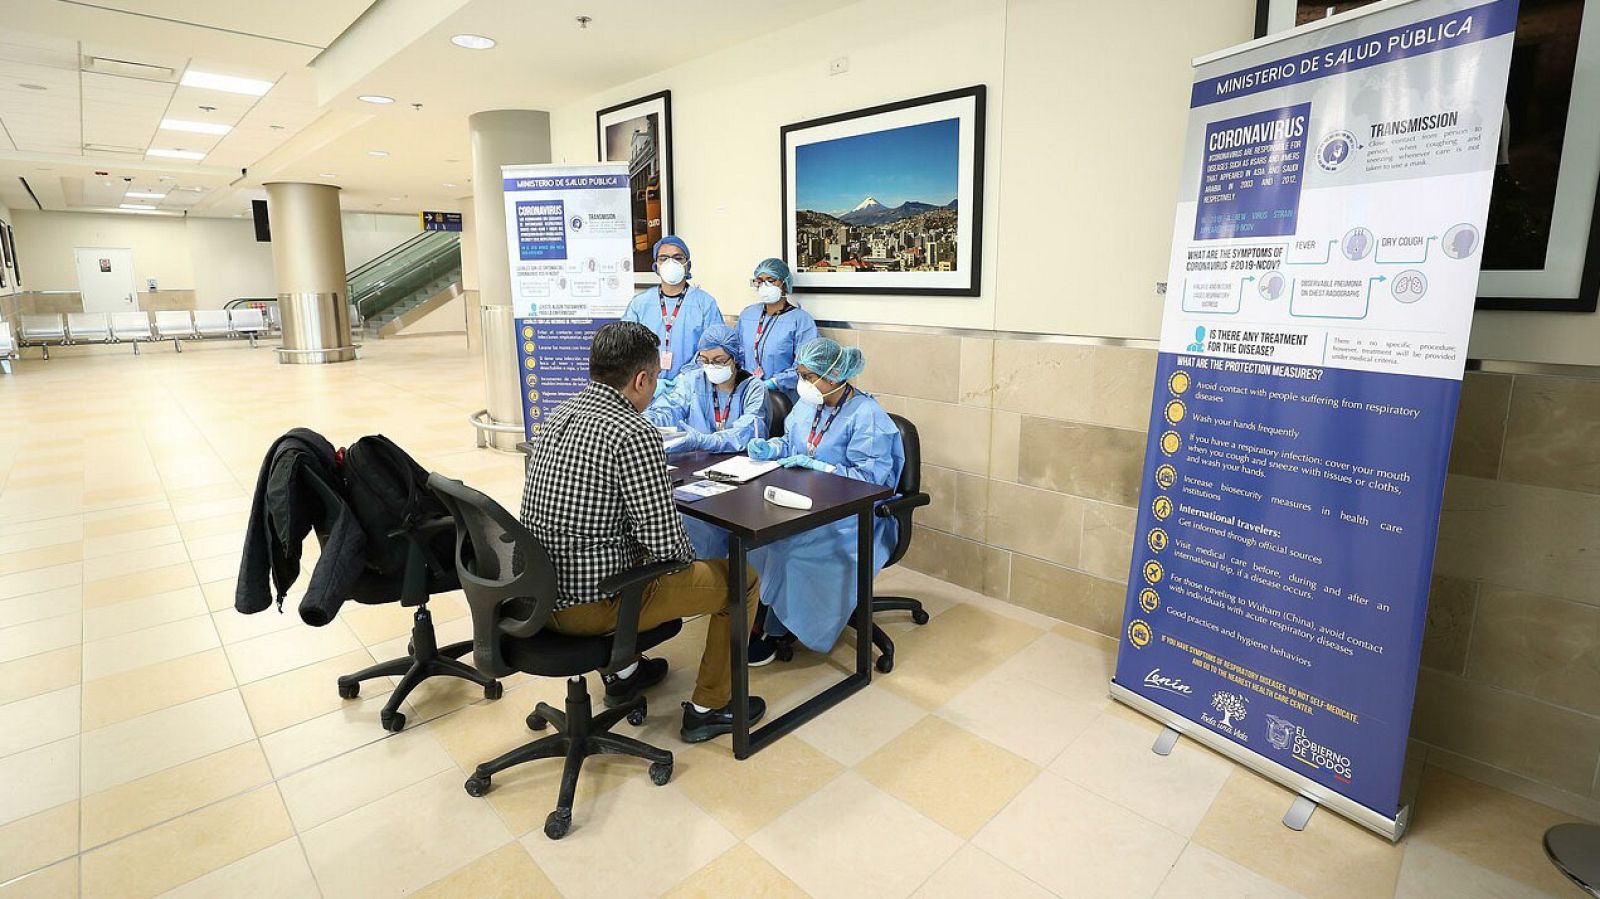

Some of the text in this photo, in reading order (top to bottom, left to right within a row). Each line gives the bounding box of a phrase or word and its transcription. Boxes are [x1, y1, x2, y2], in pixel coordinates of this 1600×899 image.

[1217, 16, 1472, 95] MINISTERIO DE SALUD PÚBLICA
[1209, 117, 1304, 151] CORONAVIRUS
[1371, 111, 1458, 138] TRANSMISSION
[1291, 140, 1301, 149] FOR
[1230, 161, 1241, 169] SUCH
[1283, 164, 1298, 173] SAUDI
[516, 179, 555, 188] MINISTERIO
[555, 179, 564, 187] DE
[565, 178, 588, 186] SALUD
[1261, 178, 1275, 187] AND
[1188, 248, 1283, 259] WHAT ARE THE SYMPTOMS OF
[1296, 241, 1316, 249] FEVER
[1382, 236, 1423, 247] DRY COUGH
[1186, 261, 1228, 271] CORONAVIRUS
[1207, 342, 1275, 356] FOR THE DISEASE?
[1210, 329, 1308, 346] IS THERE ANY TREATMENT
[1177, 356, 1324, 381] WHAT ARE THE PROTECTION MEASURES?
[1195, 392, 1223, 402] diseases
[1196, 382, 1420, 419] Avoid contact with people suffering from respiratory
[1193, 413, 1212, 423] Wash
[1233, 420, 1256, 430] hands
[1258, 424, 1299, 439] frequently
[1188, 445, 1207, 454] when
[1226, 453, 1249, 463] cough
[1251, 458, 1267, 466] and
[1269, 462, 1298, 472] sneeze
[1301, 467, 1321, 476] with
[1324, 471, 1352, 483] tissues
[1368, 480, 1401, 495] cloths,
[1201, 459, 1220, 467] wash
[1222, 463, 1240, 471] your
[1241, 465, 1266, 477] hands.
[1211, 437, 1229, 447] have
[1238, 444, 1278, 459] respiratory
[1281, 450, 1322, 465] infection:
[1325, 460, 1350, 470] cover
[1352, 466, 1375, 475] your
[1377, 470, 1410, 482] mouth
[1183, 487, 1220, 501] institutions
[1184, 475, 1403, 533] Increase biosecurity measures in health care
[1179, 504, 1280, 538] International travelers:
[1178, 518, 1322, 564] Get informed through official sources
[1174, 551, 1313, 599] international trip, disease occurs.
[1176, 539, 1390, 612] Visit medical care before, during and after an
[1169, 585, 1353, 655] with individuals with acute respiratory diseases
[1171, 573, 1383, 654] For those traveling to Wuham (China), avoid contact
[1167, 607, 1311, 667] Good practices and hygiene behaviors
[1167, 637, 1359, 724] YOU HAVE SYMPTOMS RESPIRATORY DISEASES, DO NOT SELF-MEDICATE.
[1192, 658, 1313, 715] AND GO TO THE NEAREST HEALTH CARE CENTER.
[1201, 713, 1216, 726] Toda
[1296, 726, 1307, 738] EL
[1293, 743, 1351, 778] DE TODOS
[1295, 735, 1351, 769] GOBIERNO
